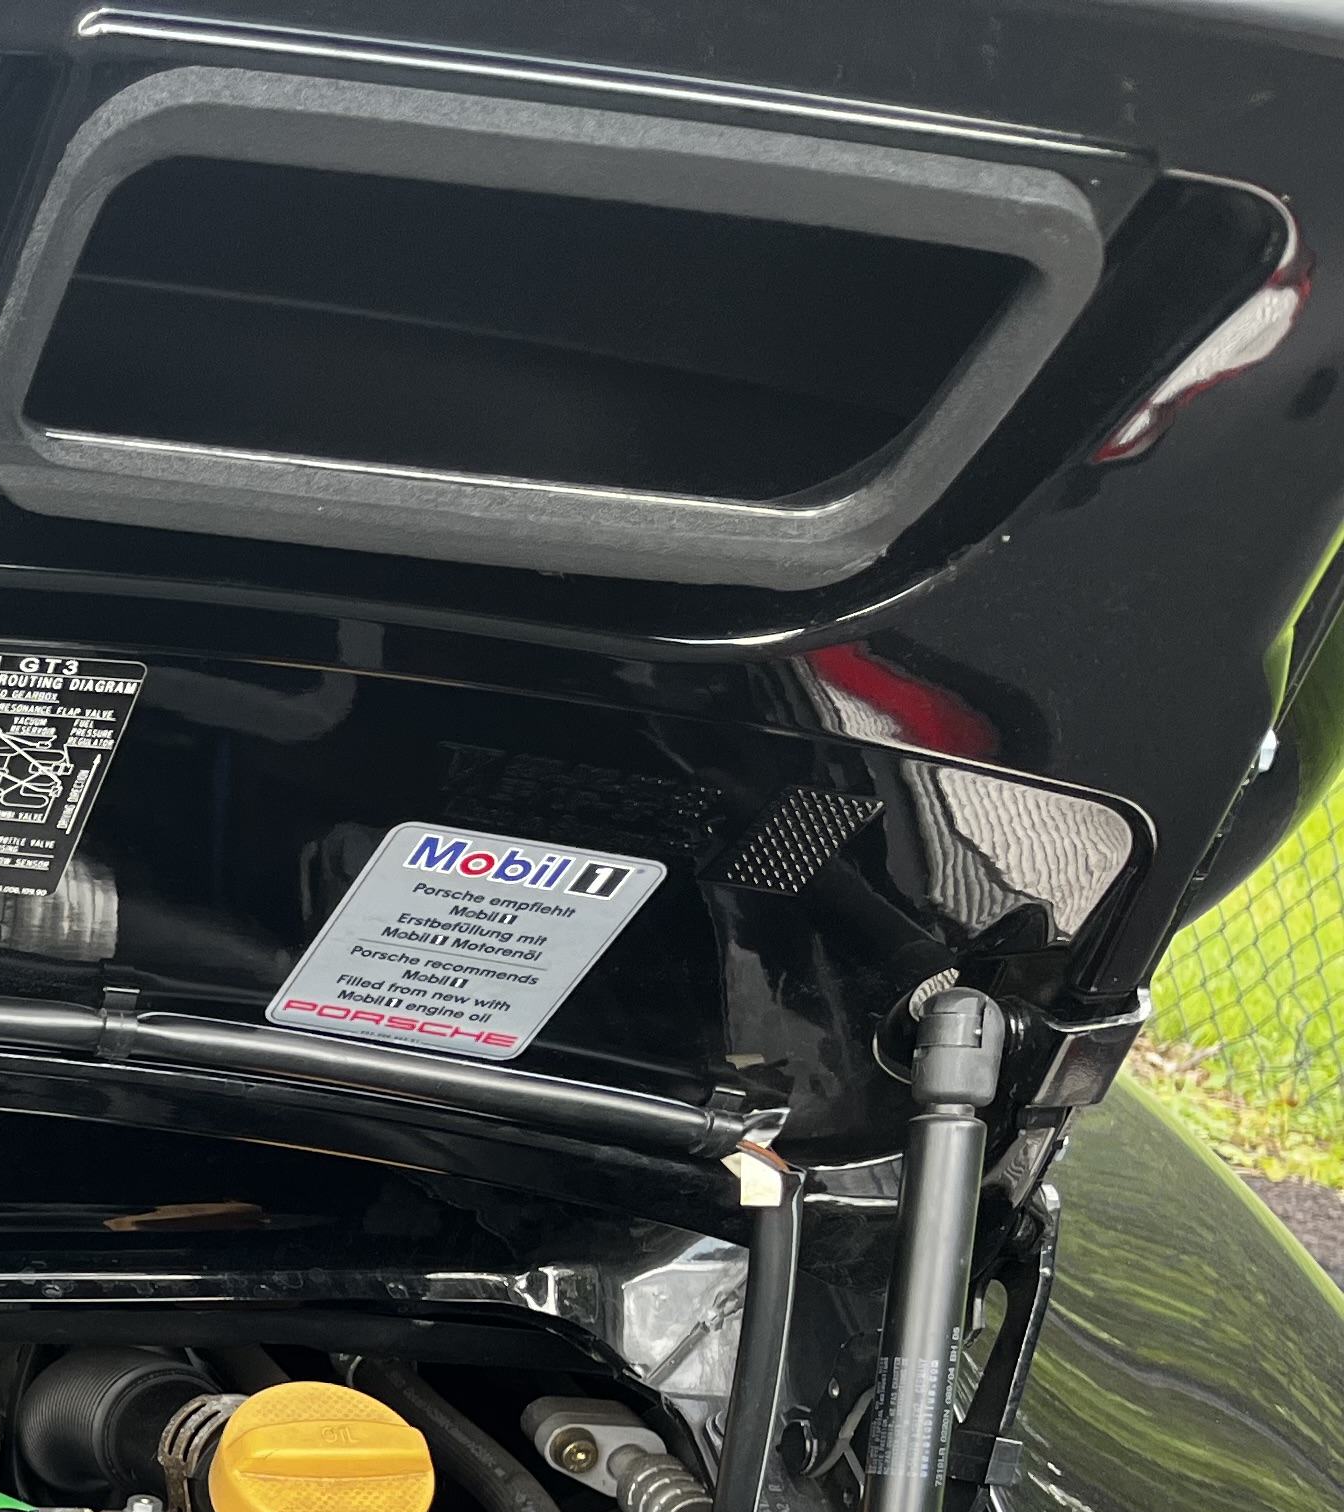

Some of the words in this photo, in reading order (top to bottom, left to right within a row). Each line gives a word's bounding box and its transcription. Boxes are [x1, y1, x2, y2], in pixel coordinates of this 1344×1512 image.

[19, 658, 80, 675] GT3
[11, 690, 58, 700] GEARBOX
[70, 678, 137, 694] DIAGRAM
[57, 707, 82, 716] FLAP
[85, 709, 114, 718] VALVE
[73, 720, 94, 728] FUEL
[15, 858, 50, 868] SENSOR
[407, 835, 574, 889] Mobil
[413, 883, 486, 905] Porsche
[489, 896, 577, 919] empfiehlt
[449, 905, 498, 922] Mobil
[396, 913, 513, 943] Erstbefüllung
[517, 933, 548, 947] mit
[381, 927, 429, 944] Mobil
[451, 938, 543, 962] Motorenöl
[350, 946, 420, 967] Porsche
[424, 960, 539, 986] recommends
[402, 970, 451, 988] Mobil
[336, 975, 384, 993] Filled
[387, 981, 428, 998] from
[432, 990, 470, 1004] new
[474, 998, 511, 1012] with
[337, 990, 385, 1008] Mobil
[405, 1003, 464, 1022] engine
[468, 1012, 491, 1024] oil
[282, 999, 518, 1048] PORSCHE
